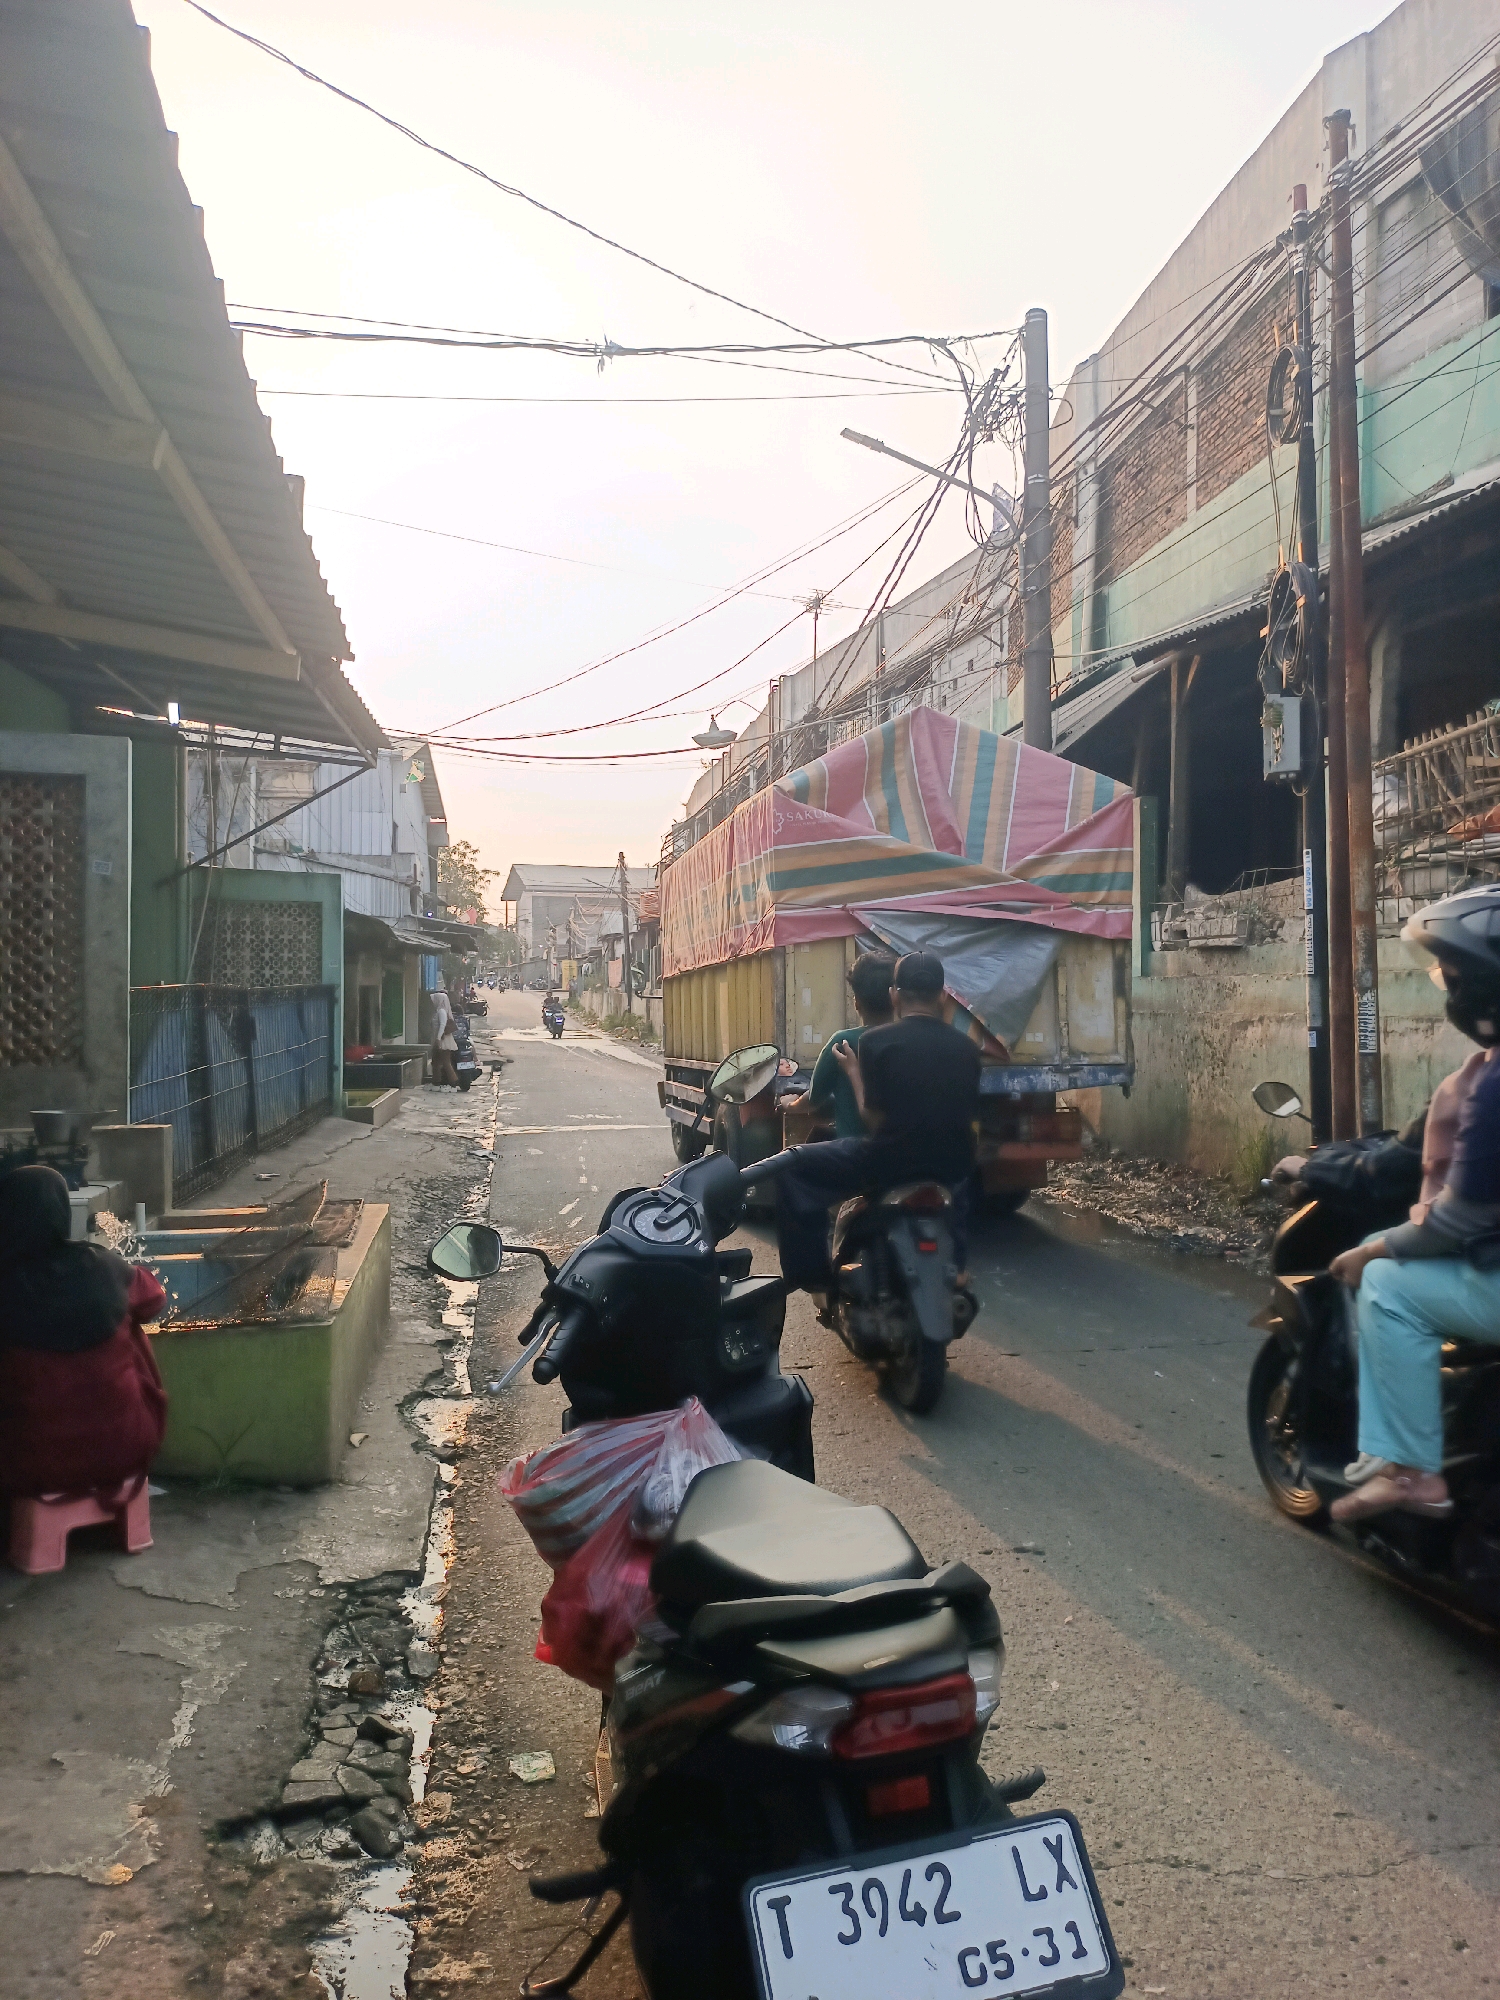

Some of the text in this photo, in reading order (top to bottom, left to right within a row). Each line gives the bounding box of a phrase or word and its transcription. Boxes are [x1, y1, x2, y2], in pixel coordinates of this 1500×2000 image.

[766, 1833, 1079, 1960] T 3942 LX
